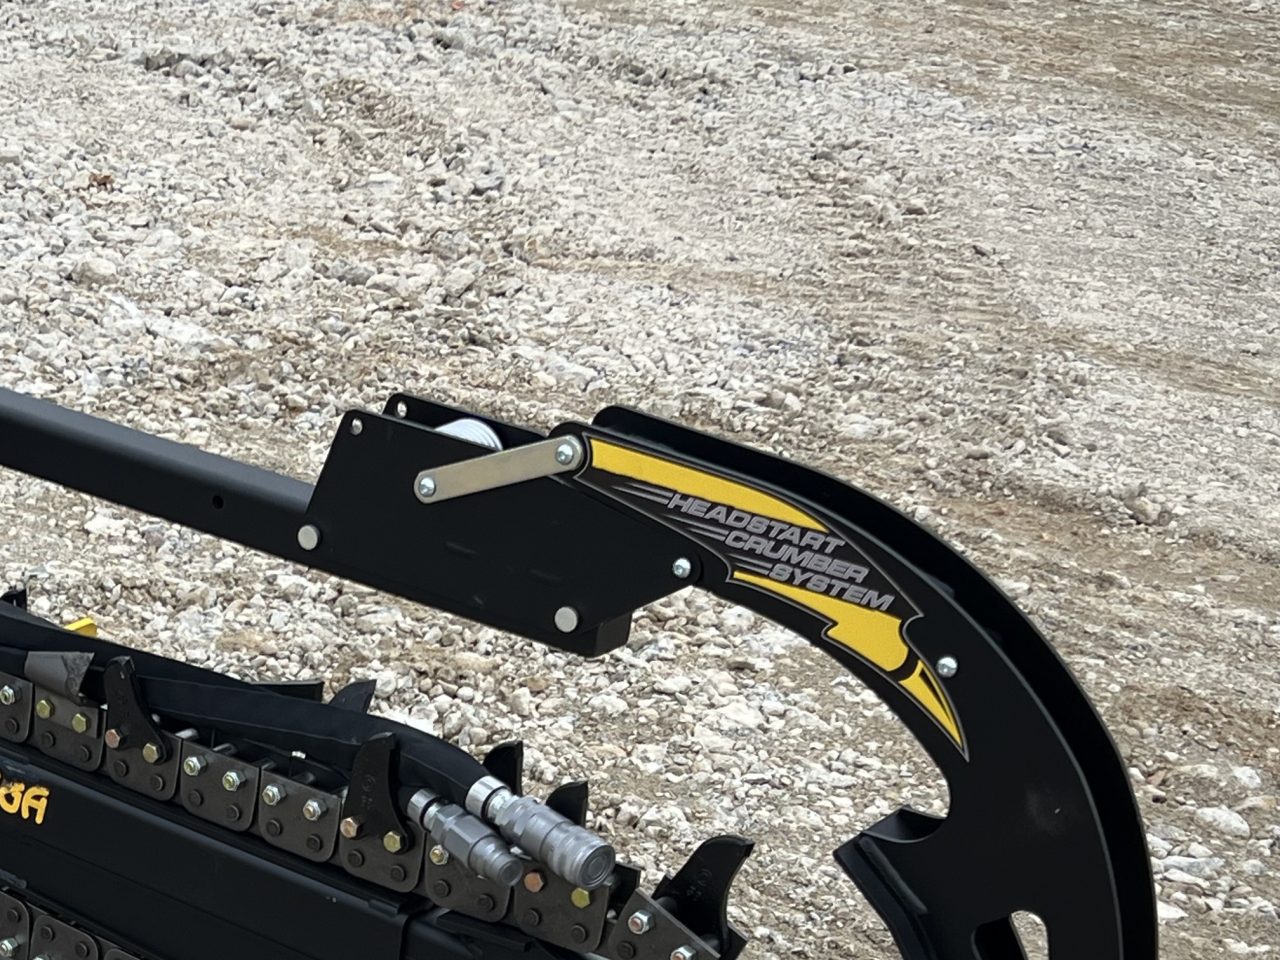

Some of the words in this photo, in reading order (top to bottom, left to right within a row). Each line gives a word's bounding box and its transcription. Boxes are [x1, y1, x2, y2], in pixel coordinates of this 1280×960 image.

[667, 494, 845, 554] HEADSTART
[725, 531, 868, 582] CRUMBER
[770, 564, 895, 612] SYSTEM
